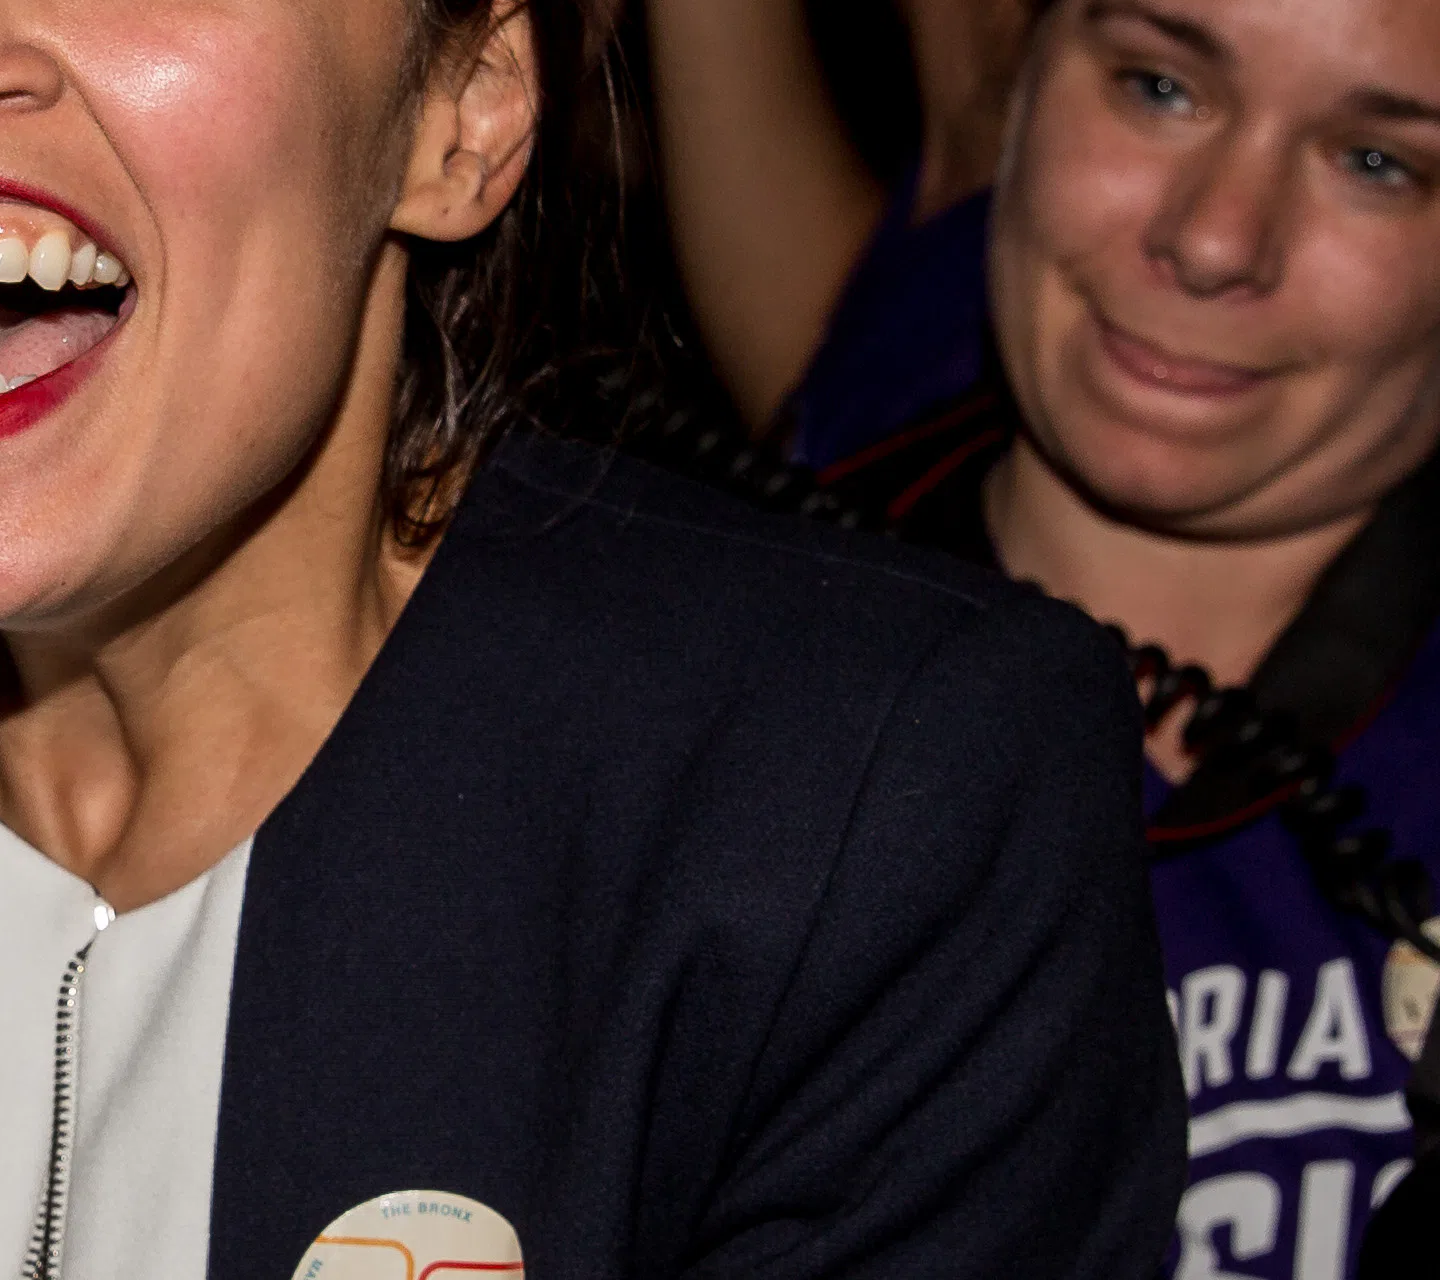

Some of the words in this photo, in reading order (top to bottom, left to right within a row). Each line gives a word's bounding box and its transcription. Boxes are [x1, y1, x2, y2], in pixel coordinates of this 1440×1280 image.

[1167, 958, 1373, 1099] RIA
[383, 1203, 412, 1220] THE
[417, 1200, 474, 1223] BRONX
